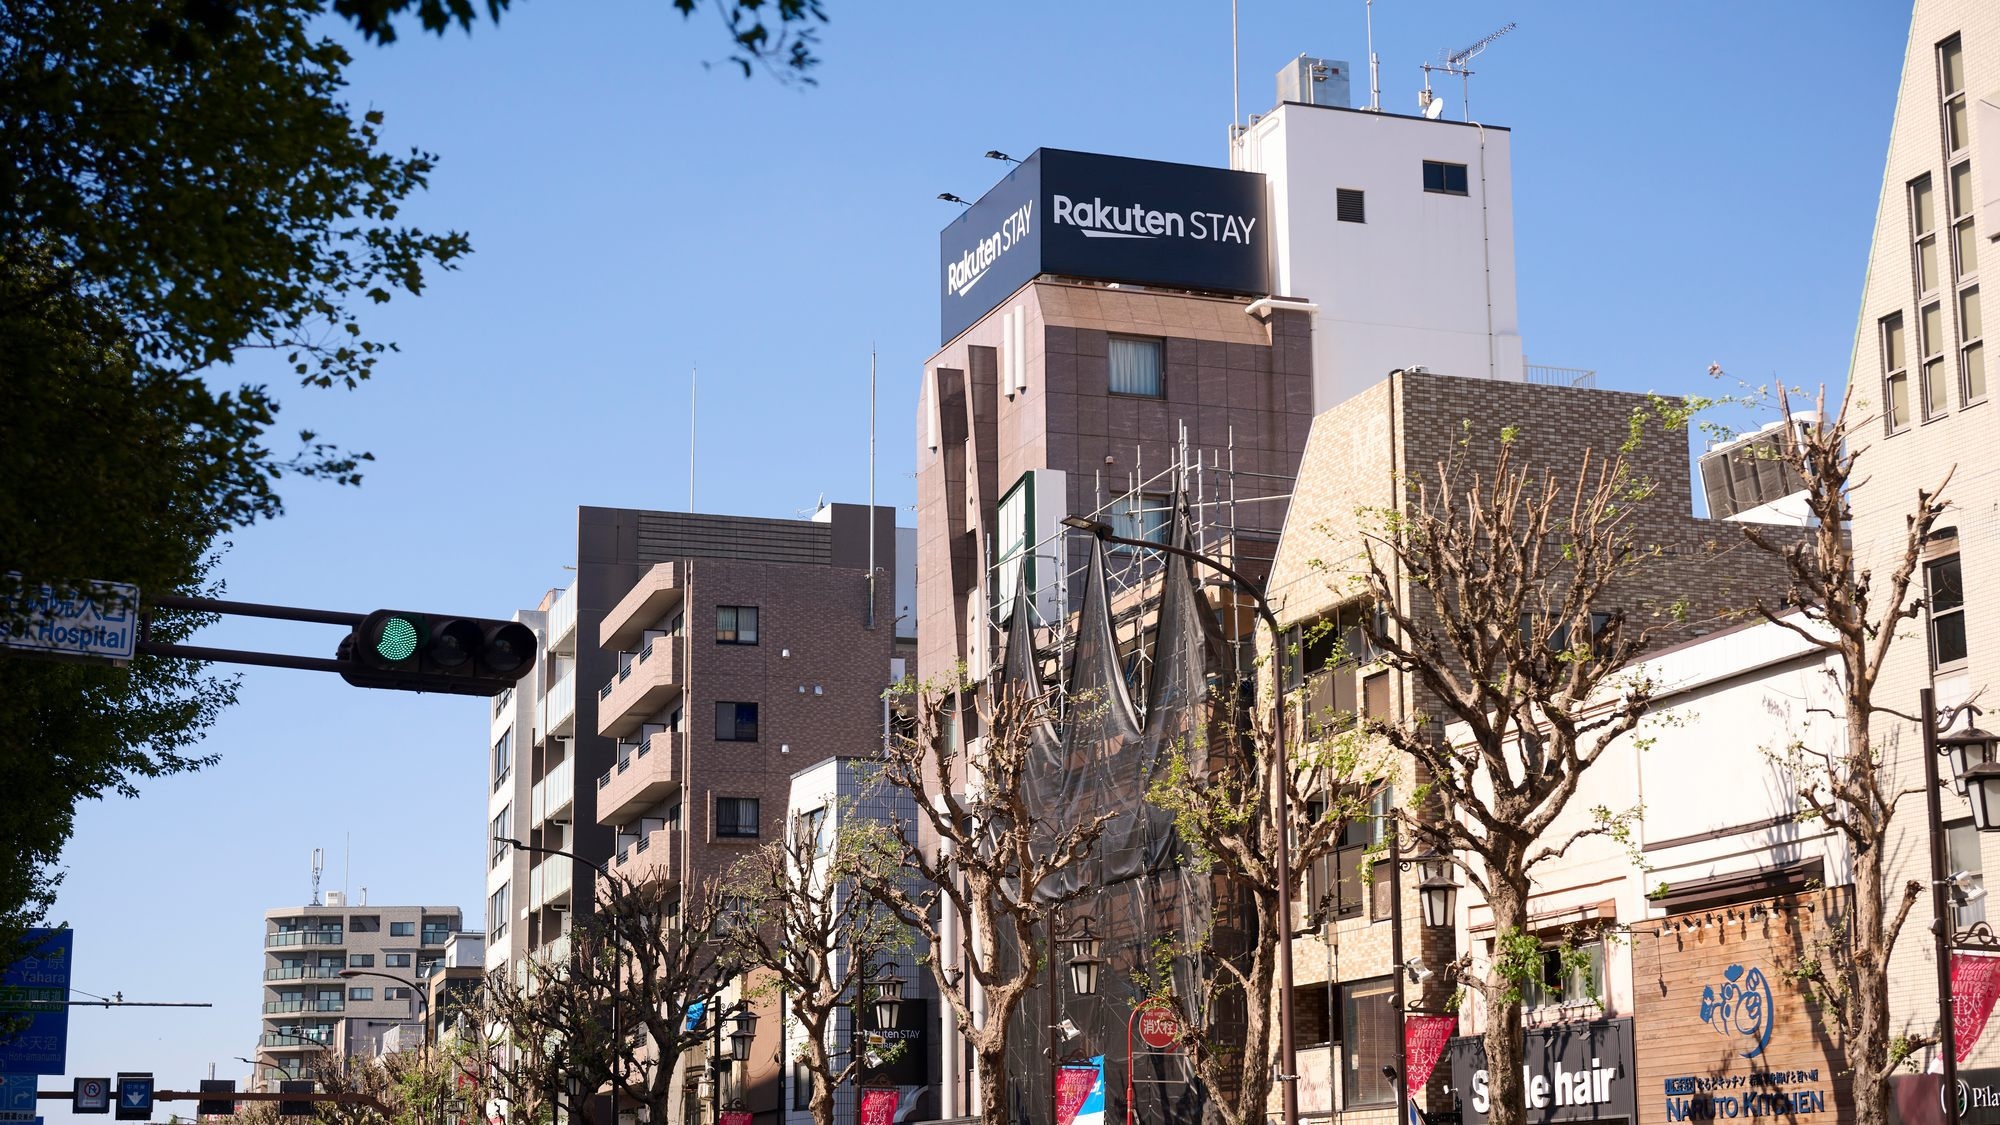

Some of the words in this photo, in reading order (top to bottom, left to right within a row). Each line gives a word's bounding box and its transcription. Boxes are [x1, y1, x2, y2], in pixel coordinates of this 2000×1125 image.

[1053, 194, 1184, 238] Rakuten
[1190, 211, 1256, 245] STAY
[948, 231, 1002, 296] Rakuten
[1002, 199, 1033, 252] STAY
[37, 620, 127, 650] Hospital
[21, 970, 65, 983] Yahara
[900, 1029, 920, 1039] STAY
[1143, 1019, 1176, 1034] 消火栓
[14, 1035, 58, 1050] 本天沼
[1472, 1065, 1551, 1114] Sle
[1554, 1058, 1616, 1107] hair
[1666, 1096, 1739, 1122] NARUTO
[1743, 1089, 1824, 1117] KITCHEN
